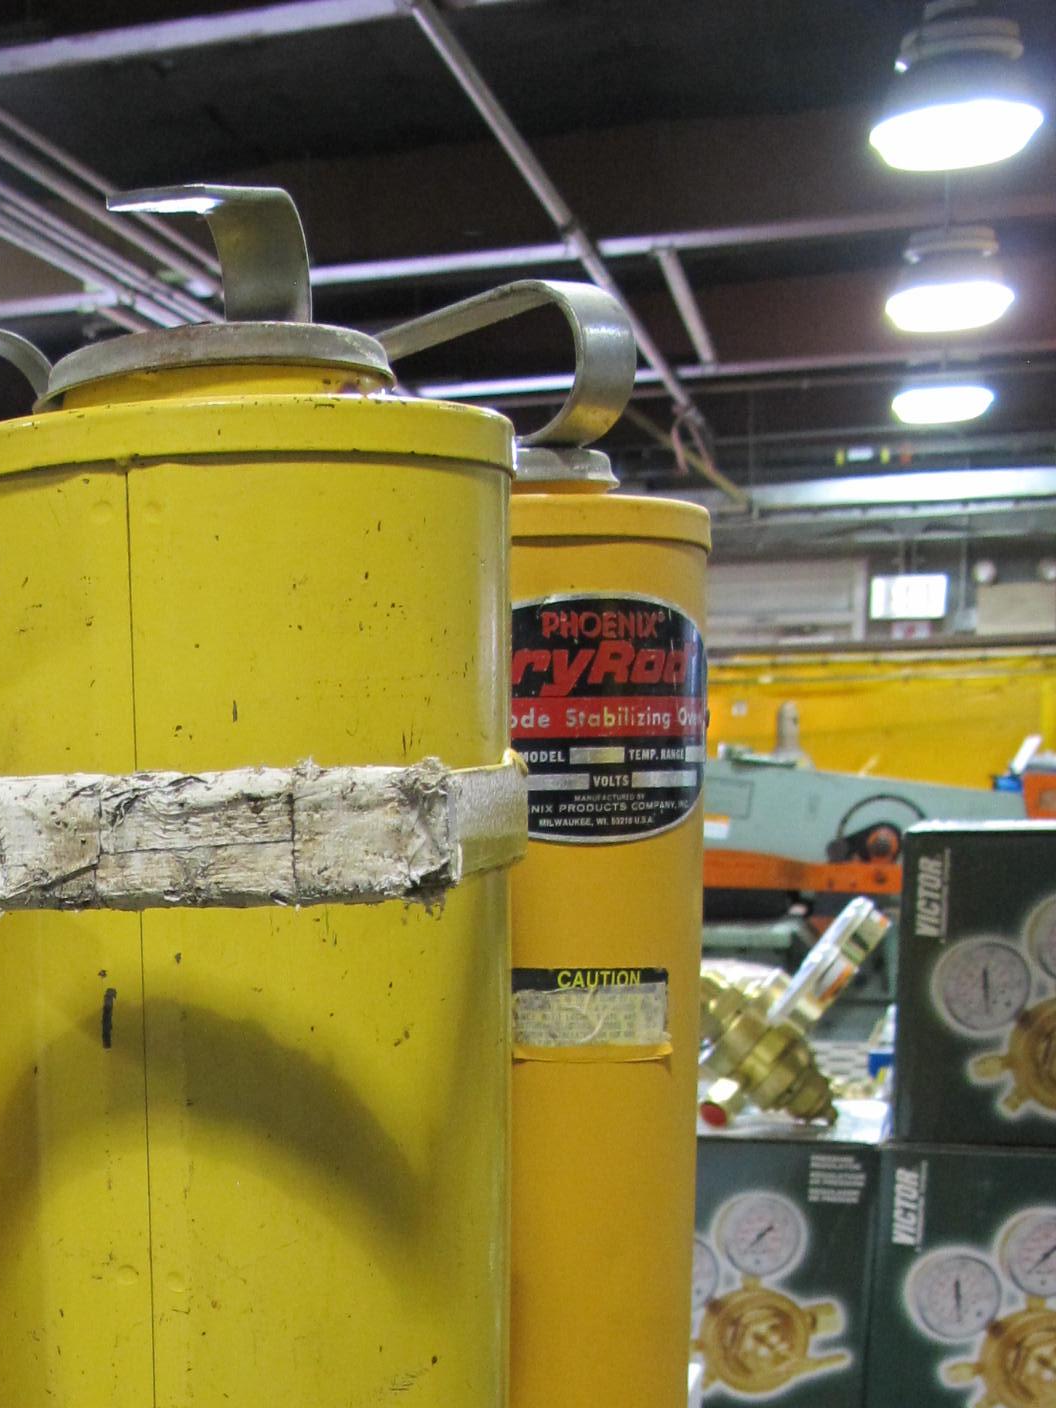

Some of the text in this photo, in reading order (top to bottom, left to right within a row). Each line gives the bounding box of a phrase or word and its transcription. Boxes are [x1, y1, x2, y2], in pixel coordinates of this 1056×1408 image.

[511, 640, 692, 698] ryRod
[566, 706, 672, 730] Stabilizing
[592, 774, 630, 788] VOLTS
[559, 802, 627, 814] PRODUCTS
[557, 970, 641, 989] CAUTION
